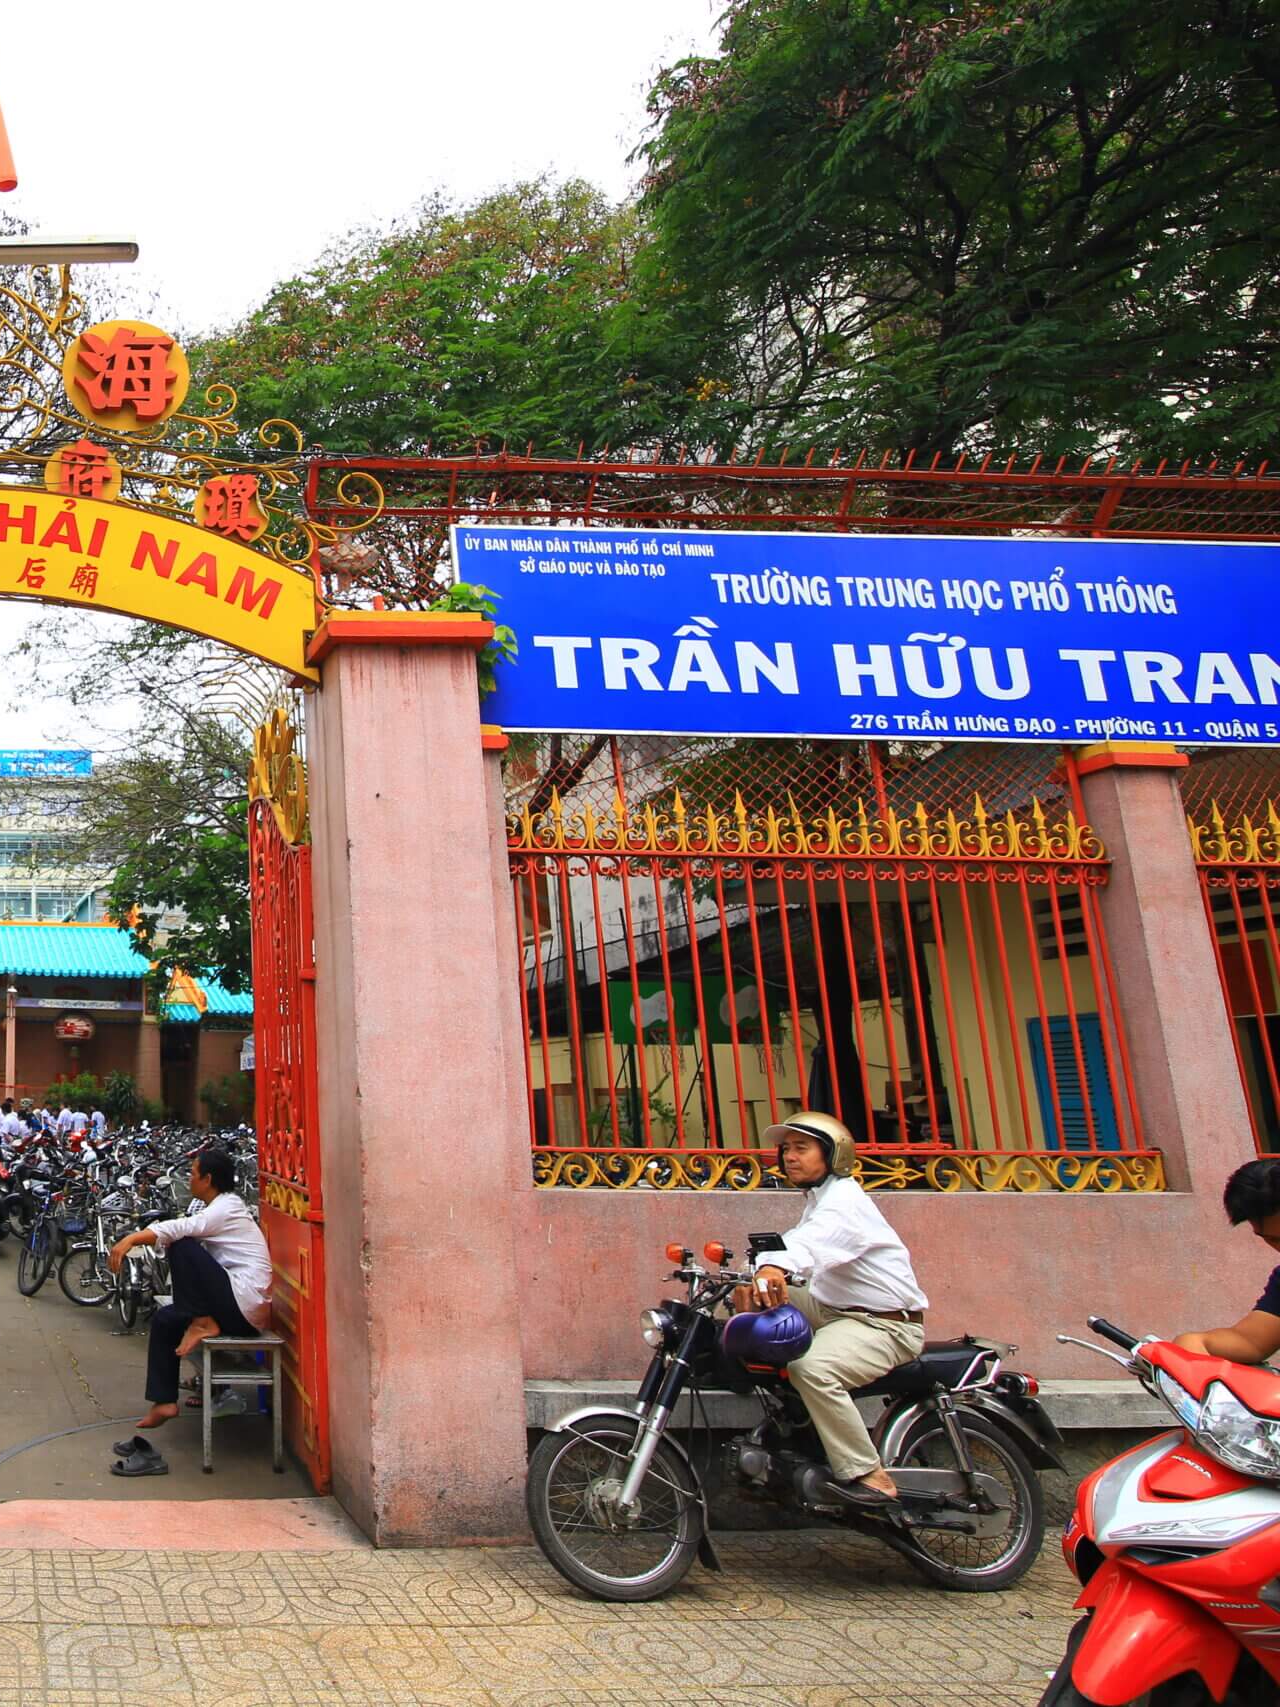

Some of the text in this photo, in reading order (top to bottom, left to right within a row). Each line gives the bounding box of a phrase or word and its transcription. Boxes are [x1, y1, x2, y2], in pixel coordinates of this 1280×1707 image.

[465, 533, 714, 557] ỦY BAN NHÂN DÂN THÀNH PHỐ HỒ CHÍ MINH
[130, 531, 283, 620] NAM
[520, 556, 666, 578] SỞ GIÁO DỤC VÀ ĐÀO TẠO
[710, 567, 1178, 616] TRƯỜNG TRUNG HỌC PHỔ THÔNG
[532, 616, 800, 695] TRẦN
[832, 632, 1031, 701] HỮU
[850, 711, 1278, 740] 276 TRẦN HƯNG ĐẠO PHƯỜNG 11 QUẬN 5
[1171, 1455, 1213, 1479] HONDA
